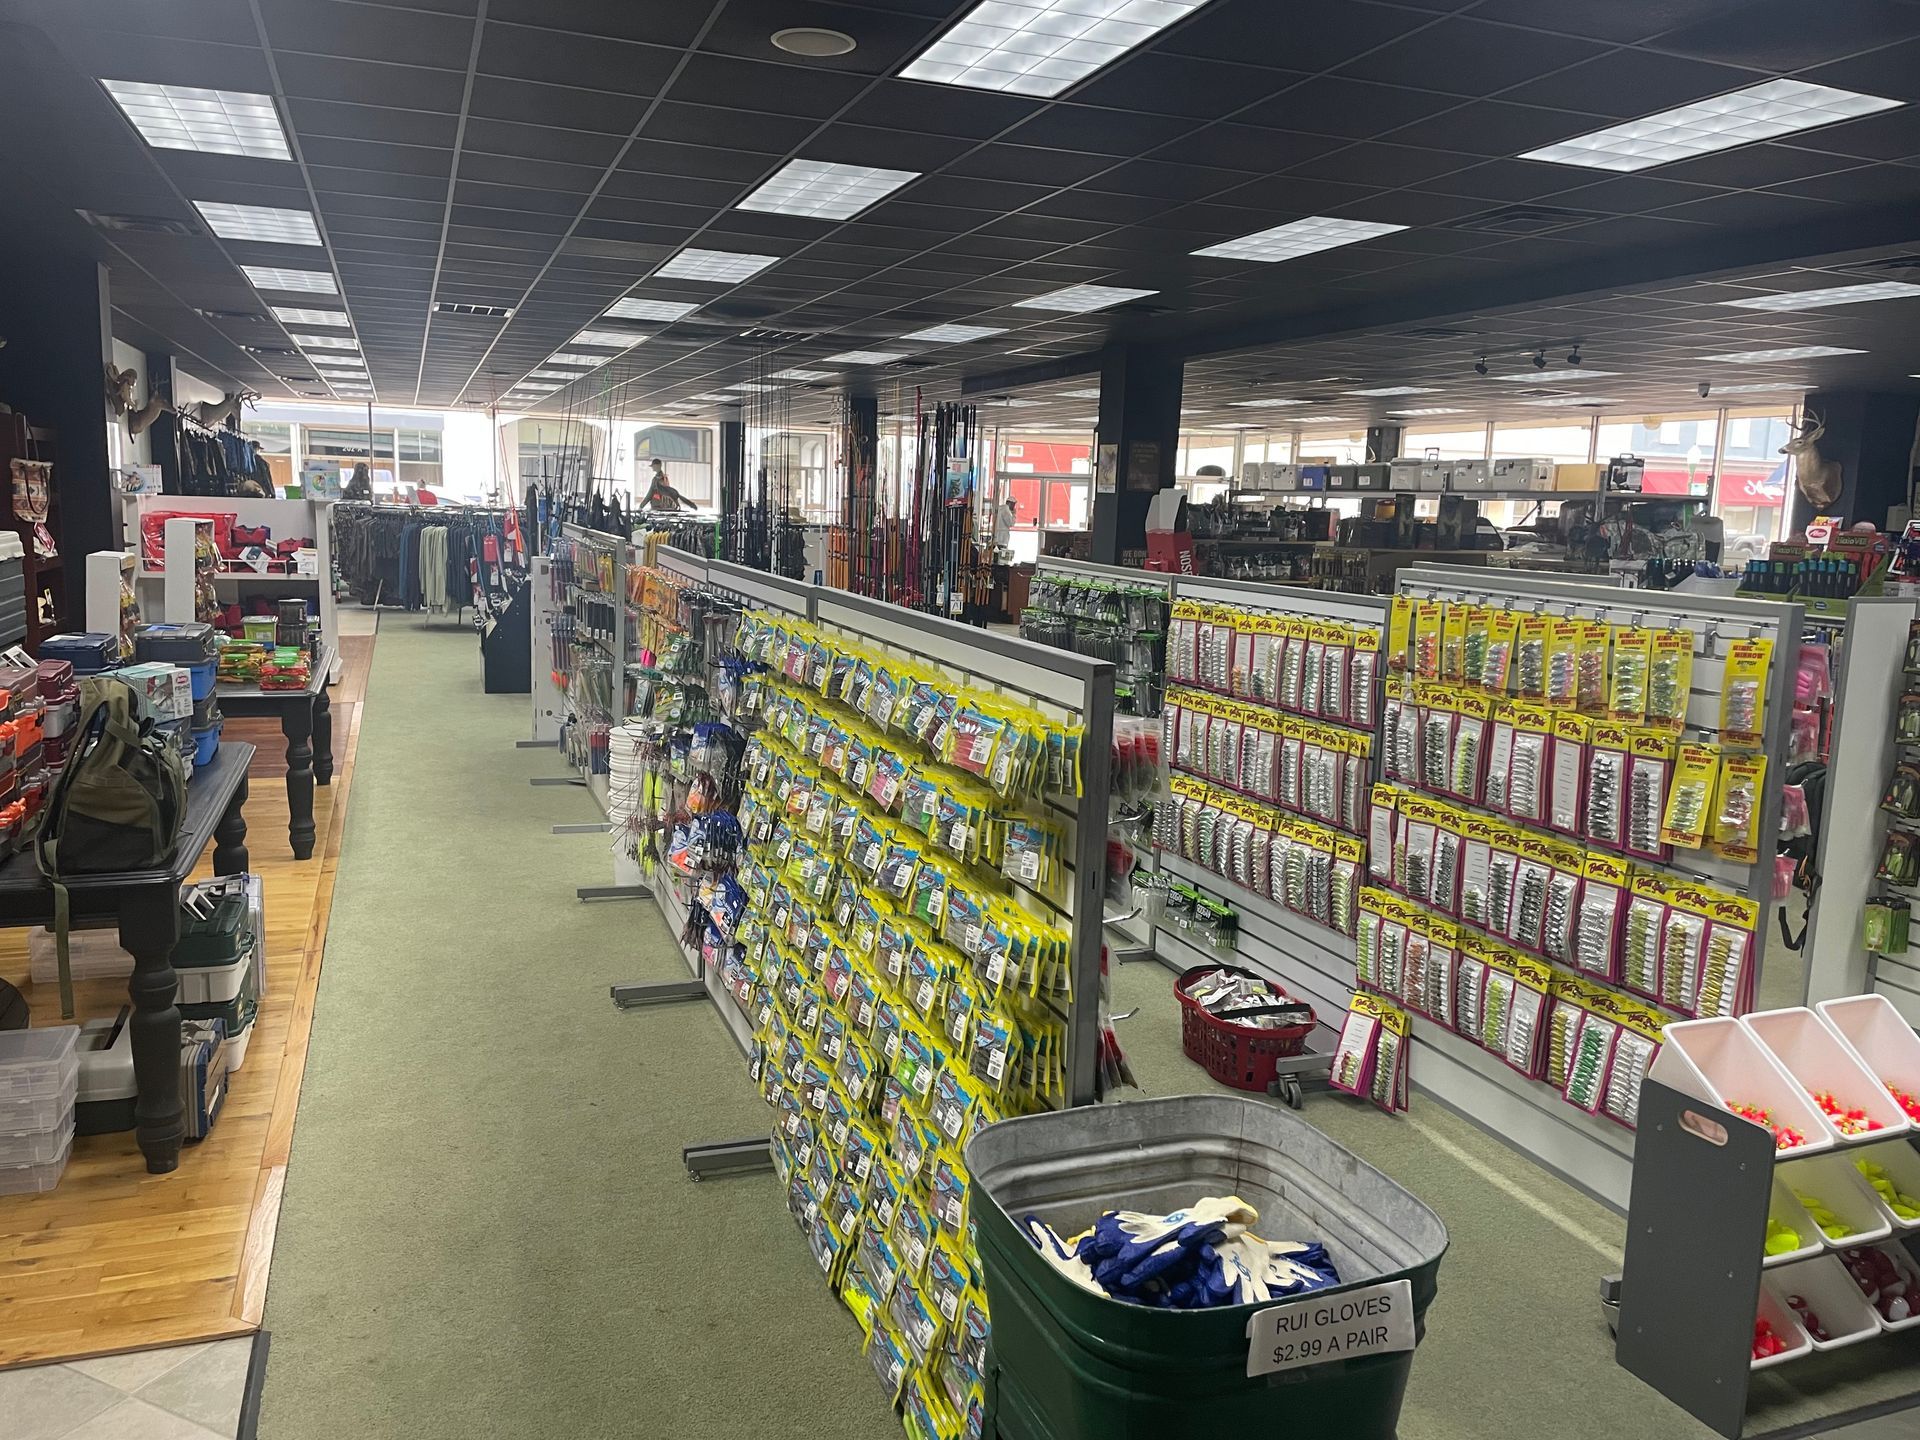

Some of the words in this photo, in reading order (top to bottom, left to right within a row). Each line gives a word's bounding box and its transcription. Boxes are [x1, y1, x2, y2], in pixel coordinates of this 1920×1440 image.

[1276, 1312, 1308, 1334] RUI
[1314, 1296, 1391, 1326] GLOVES
[1272, 1339, 1322, 1364] $2.99
[1327, 1336, 1340, 1352] A
[1346, 1326, 1388, 1350] PAIR
